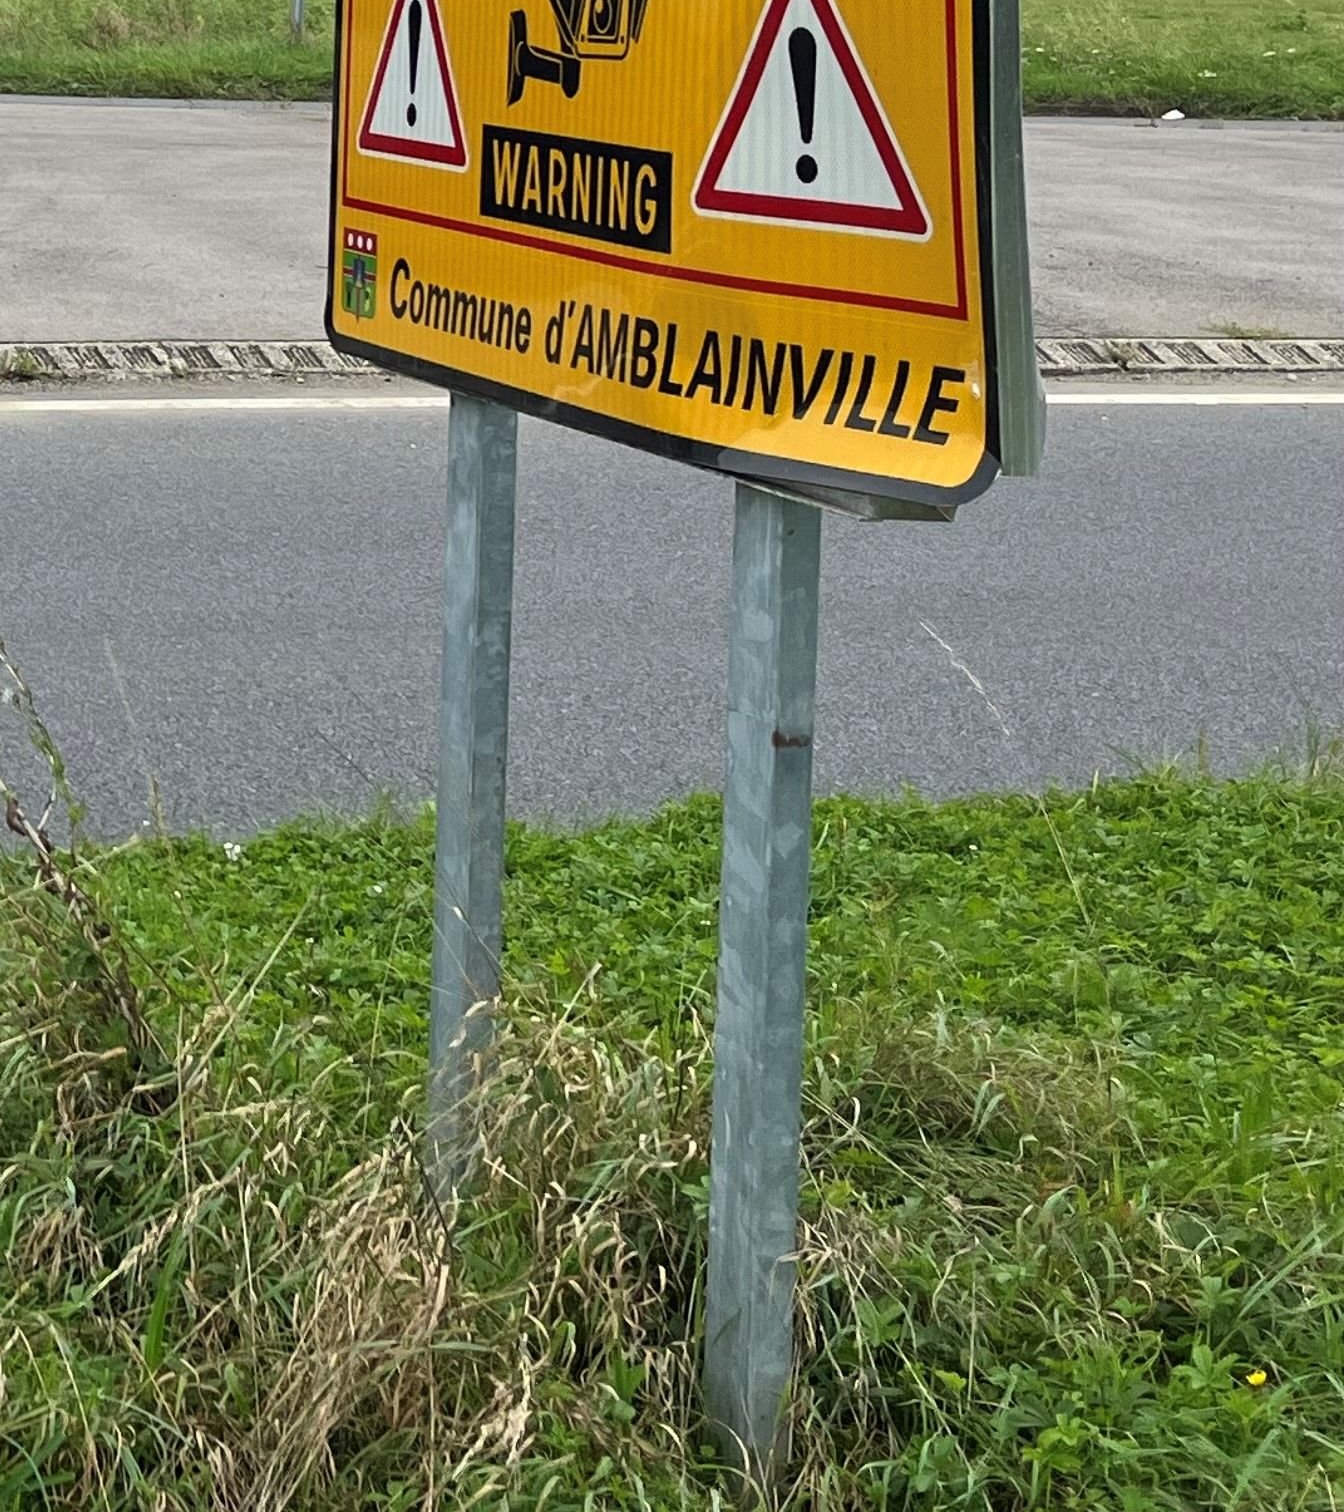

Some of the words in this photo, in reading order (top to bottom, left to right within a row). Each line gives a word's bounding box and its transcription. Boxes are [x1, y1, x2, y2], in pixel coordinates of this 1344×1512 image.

[492, 138, 657, 236] WARNING
[390, 257, 531, 355] Commune
[545, 298, 966, 447] d'AMBLAINVILLE
